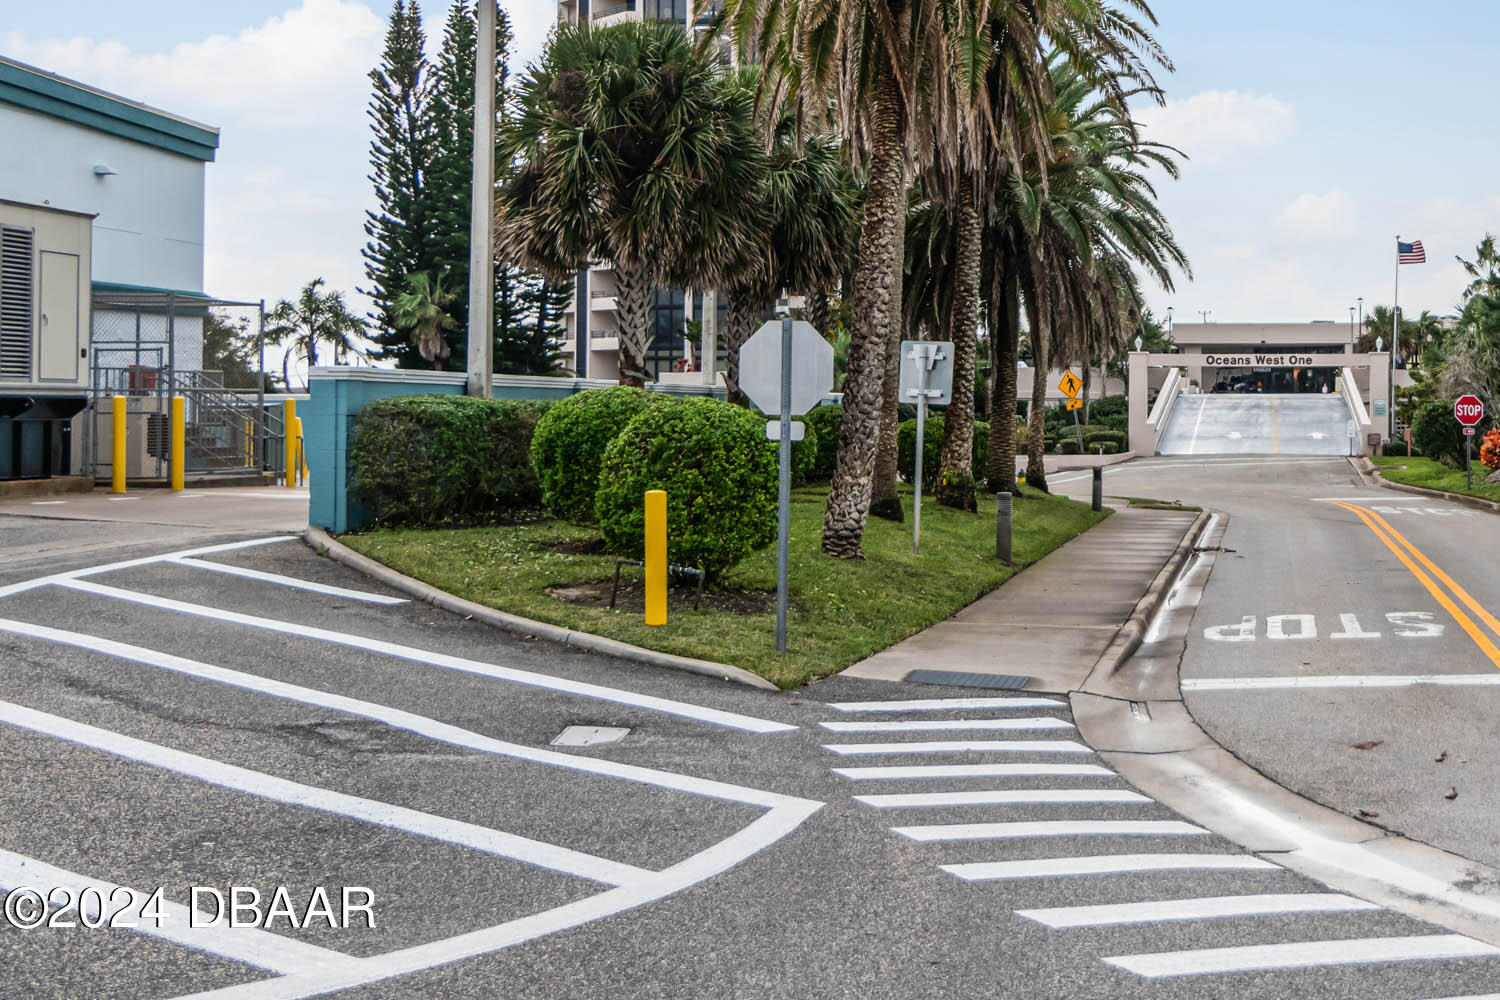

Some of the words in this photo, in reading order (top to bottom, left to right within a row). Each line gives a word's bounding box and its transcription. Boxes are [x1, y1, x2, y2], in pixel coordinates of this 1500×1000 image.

[1206, 355, 1251, 365] Oceans
[1255, 355, 1284, 365] West
[1289, 355, 1313, 365] One
[1457, 404, 1481, 416] STOP
[1203, 611, 1446, 642] STOP
